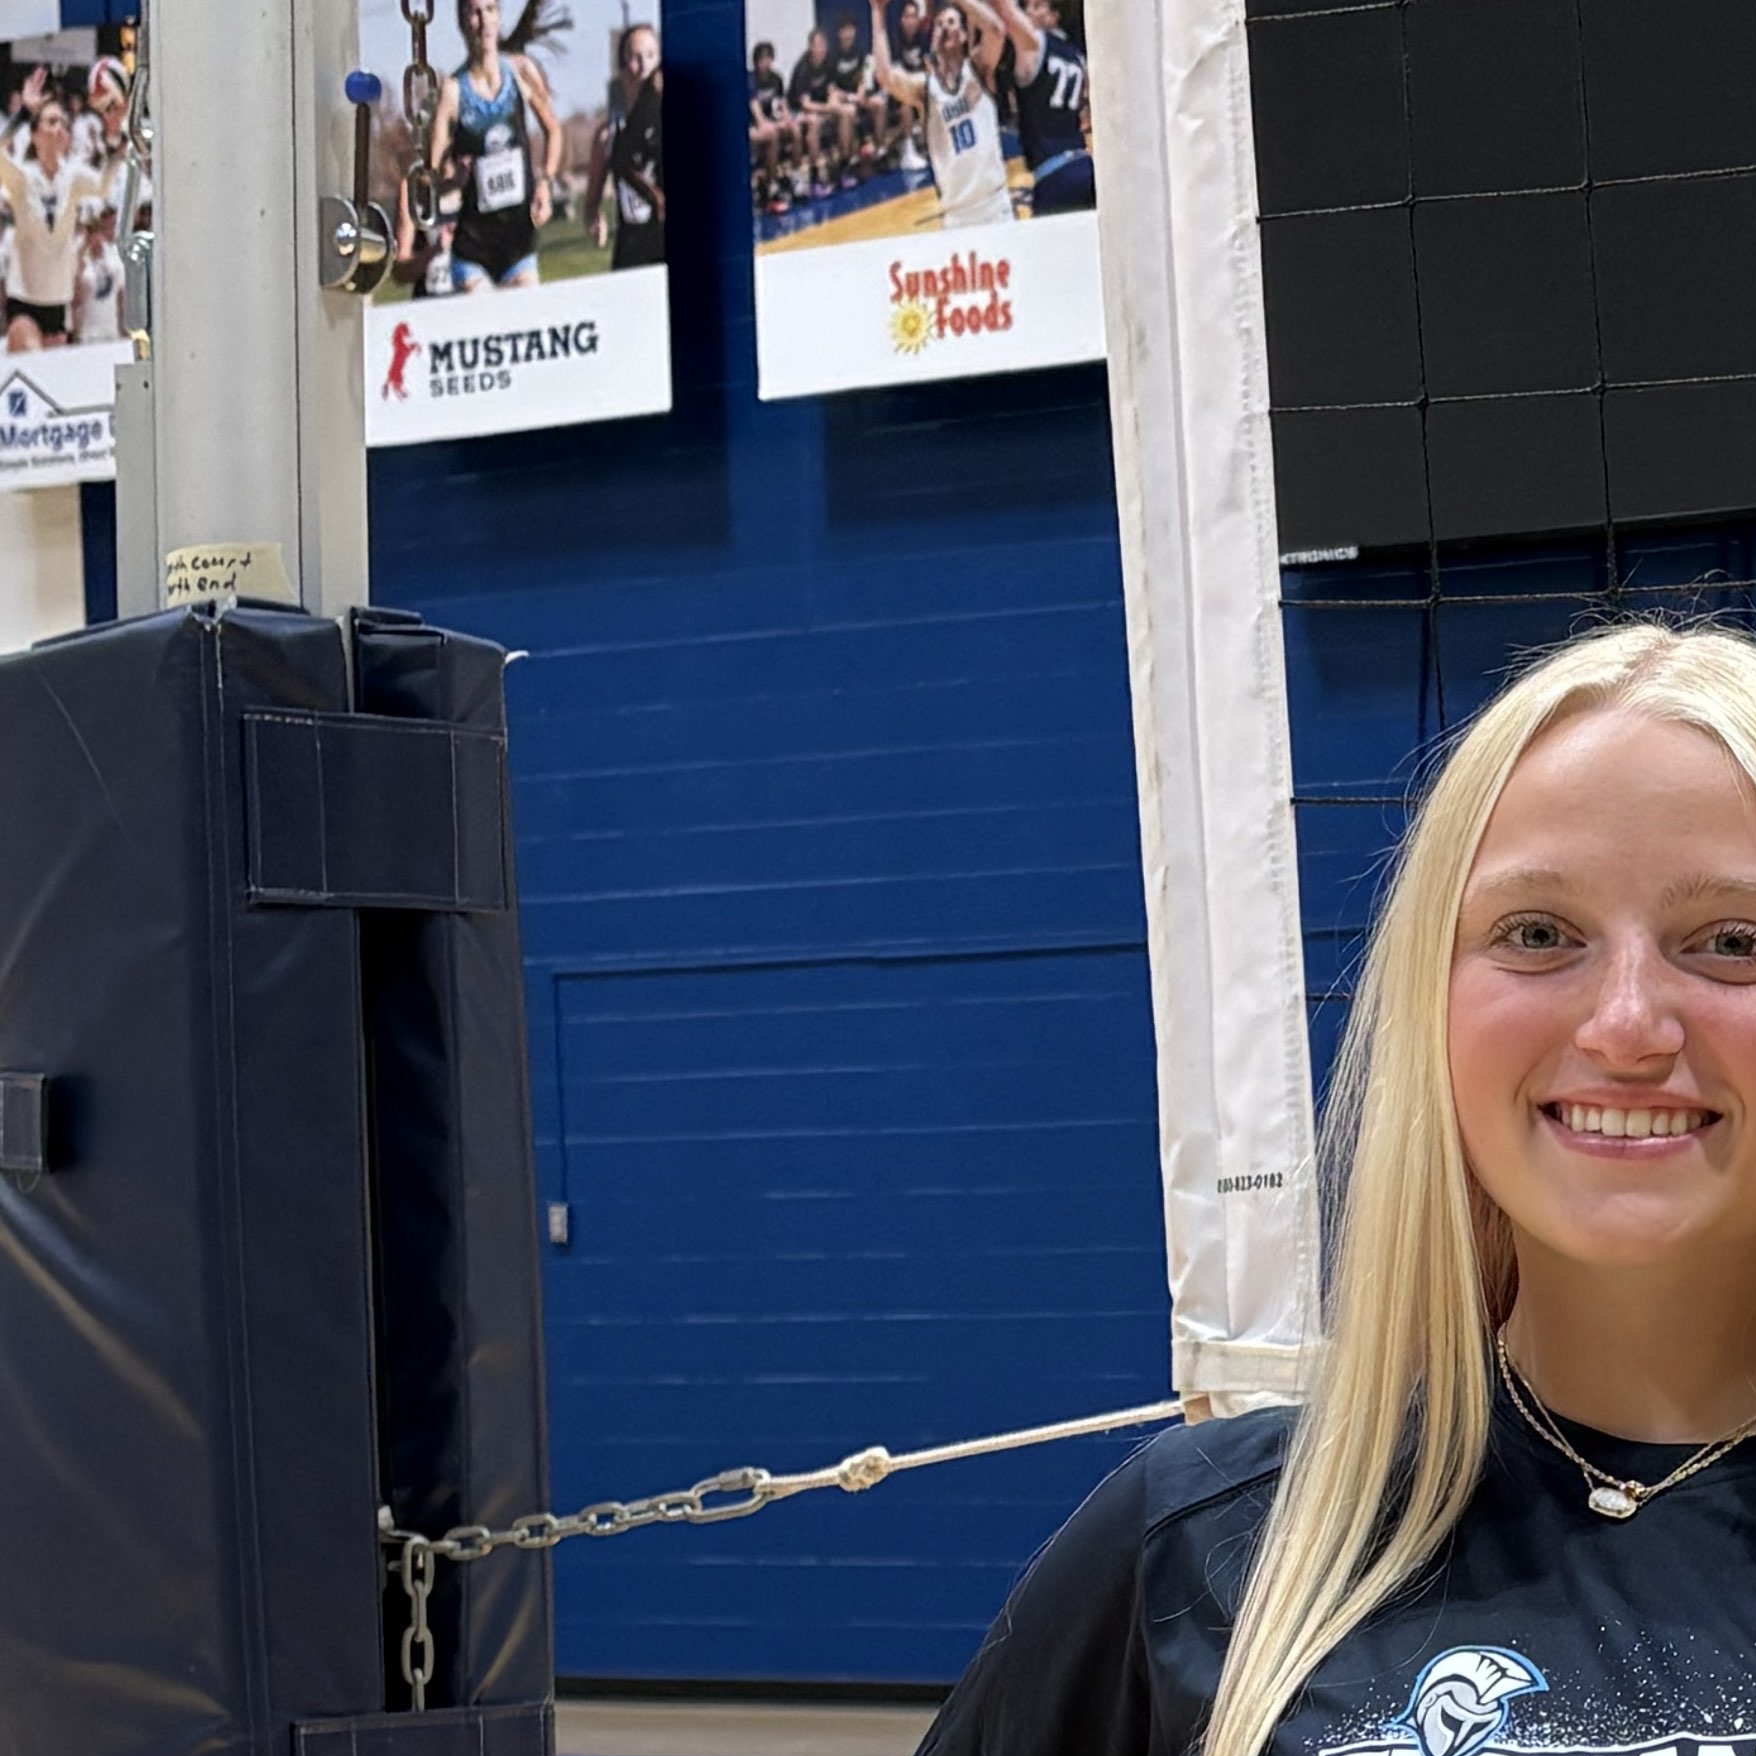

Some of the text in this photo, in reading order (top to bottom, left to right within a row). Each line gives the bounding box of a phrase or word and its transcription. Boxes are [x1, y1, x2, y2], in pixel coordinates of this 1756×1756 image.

[951, 118, 976, 155] 10
[889, 249, 1010, 304] Sunshine
[936, 288, 1013, 339] Foods
[429, 320, 599, 375] MUSTANG
[430, 370, 512, 398] SEEDS
[0, 420, 102, 453] Mortgage
